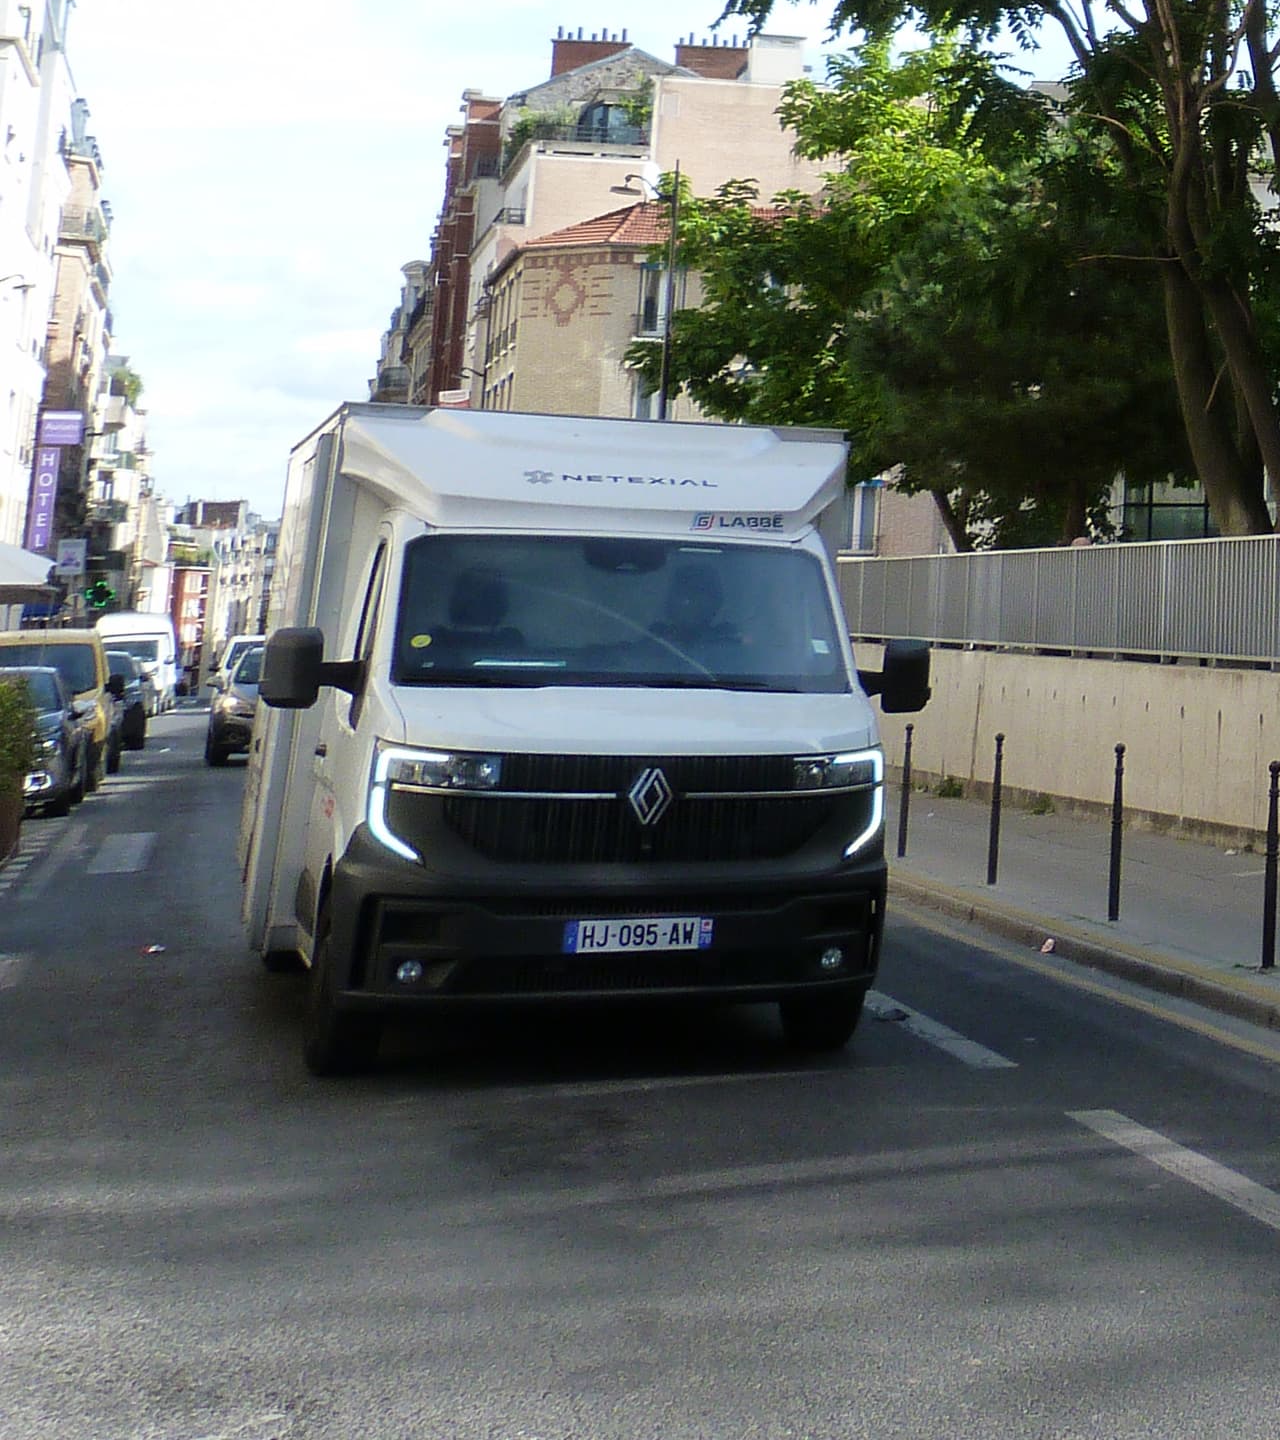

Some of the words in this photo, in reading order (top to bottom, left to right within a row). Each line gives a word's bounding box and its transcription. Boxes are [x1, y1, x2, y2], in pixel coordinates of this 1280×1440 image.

[562, 474, 718, 488] NETEXIAL
[35, 453, 55, 547] HOTEL
[582, 922, 695, 948] HJ-095-AW
